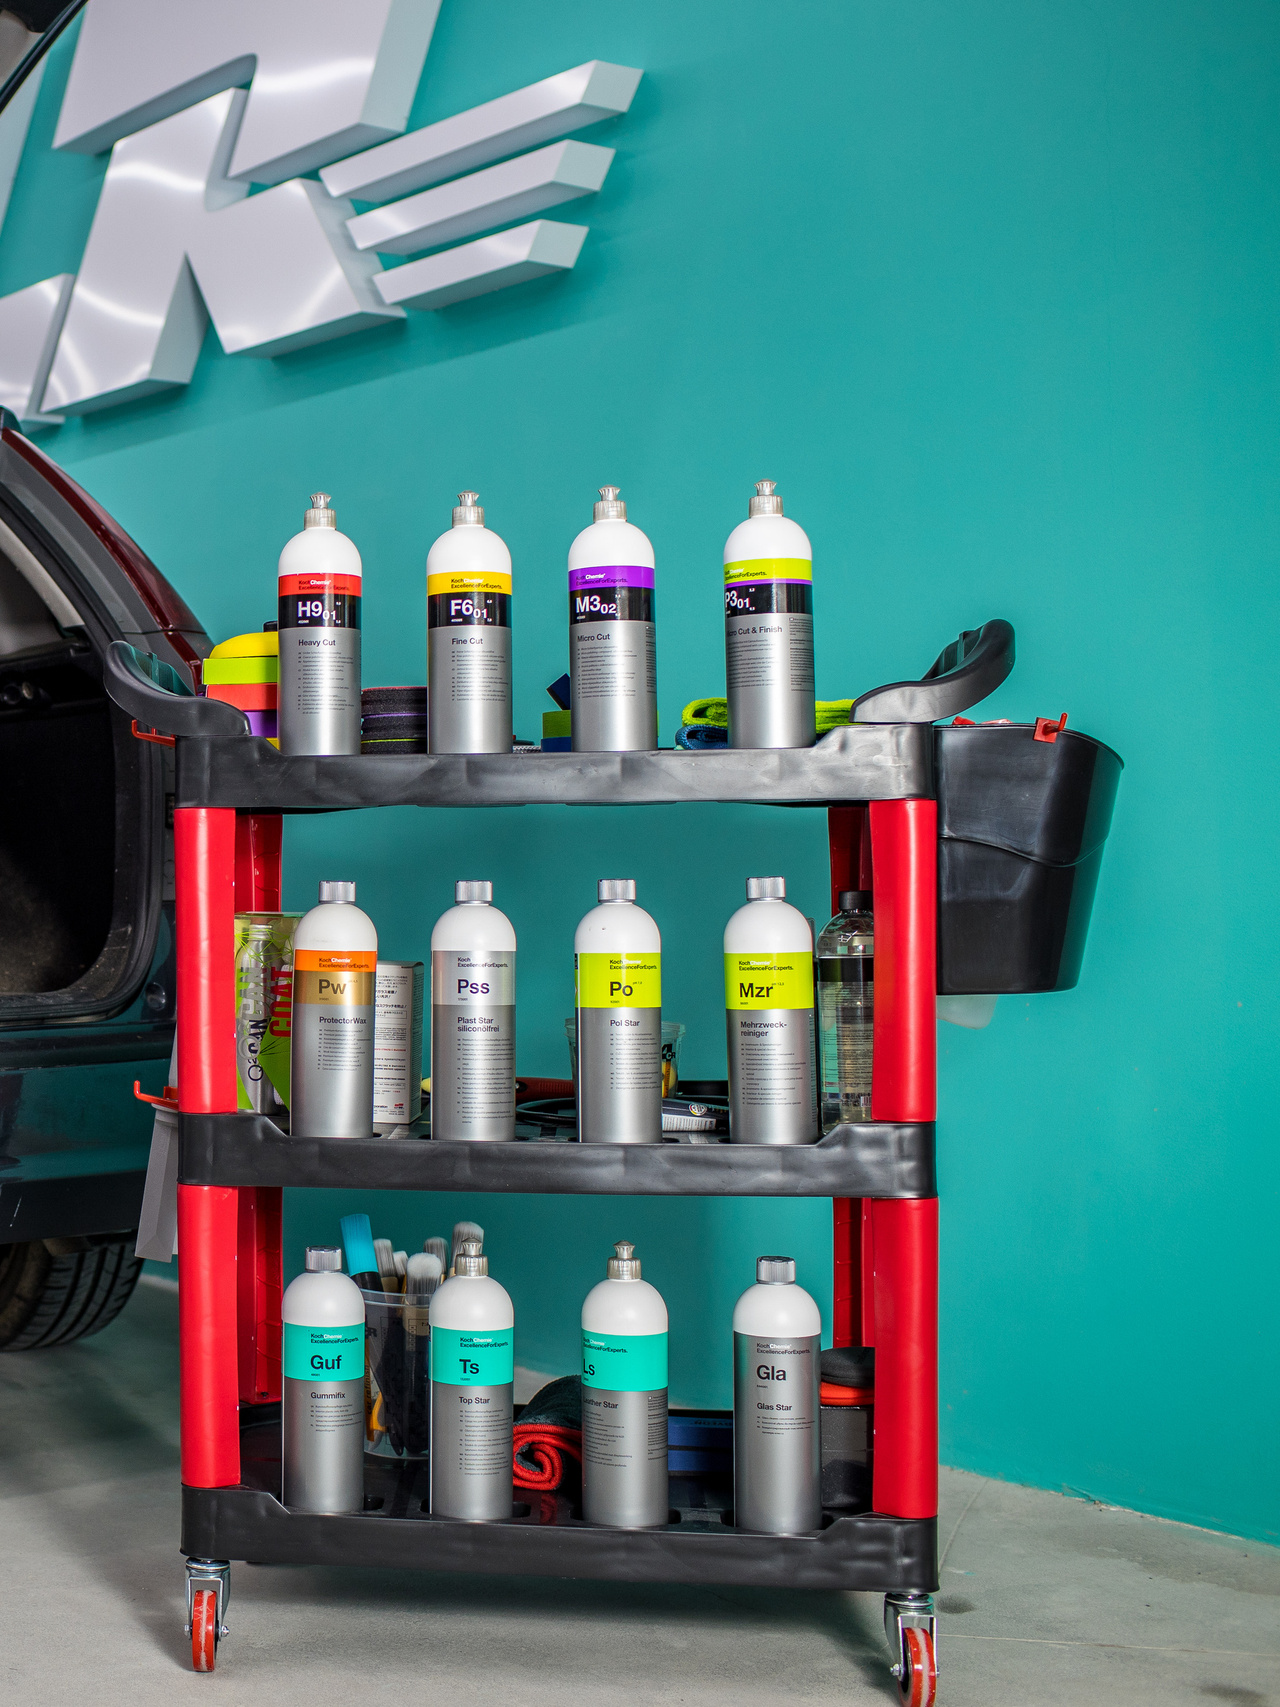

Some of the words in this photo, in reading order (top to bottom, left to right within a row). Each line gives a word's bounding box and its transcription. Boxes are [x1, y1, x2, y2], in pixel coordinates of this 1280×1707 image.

[738, 627, 751, 635] Cut
[751, 626, 758, 634] &
[759, 625, 783, 634] Finish
[469, 637, 483, 645] Cut
[577, 634, 596, 642] Micro
[596, 633, 611, 641] Cut
[298, 639, 321, 647] Heavy
[318, 978, 347, 995] Pw
[457, 978, 490, 995] Pss
[609, 981, 634, 997] Po
[738, 982, 774, 998] Mzr
[269, 966, 293, 1038] COAT
[319, 1016, 368, 1025] ProtectorWax
[457, 1016, 477, 1024] Plast
[610, 1019, 623, 1027] Pol
[624, 1019, 641, 1027] Star
[457, 1025, 500, 1033] siliconölfrei
[740, 1021, 788, 1029] Mehrzweck-
[740, 1029, 769, 1039] reiniger
[310, 1354, 342, 1370] Guf
[459, 1358, 480, 1375] Ts
[583, 1358, 595, 1376] Ls
[756, 1364, 787, 1381] Gla
[310, 1391, 346, 1399] Gummifix
[459, 1396, 473, 1405] Top
[474, 1396, 491, 1404] Star
[602, 1400, 619, 1409] Star
[756, 1402, 774, 1410] Glas
[775, 1403, 793, 1411] Star
